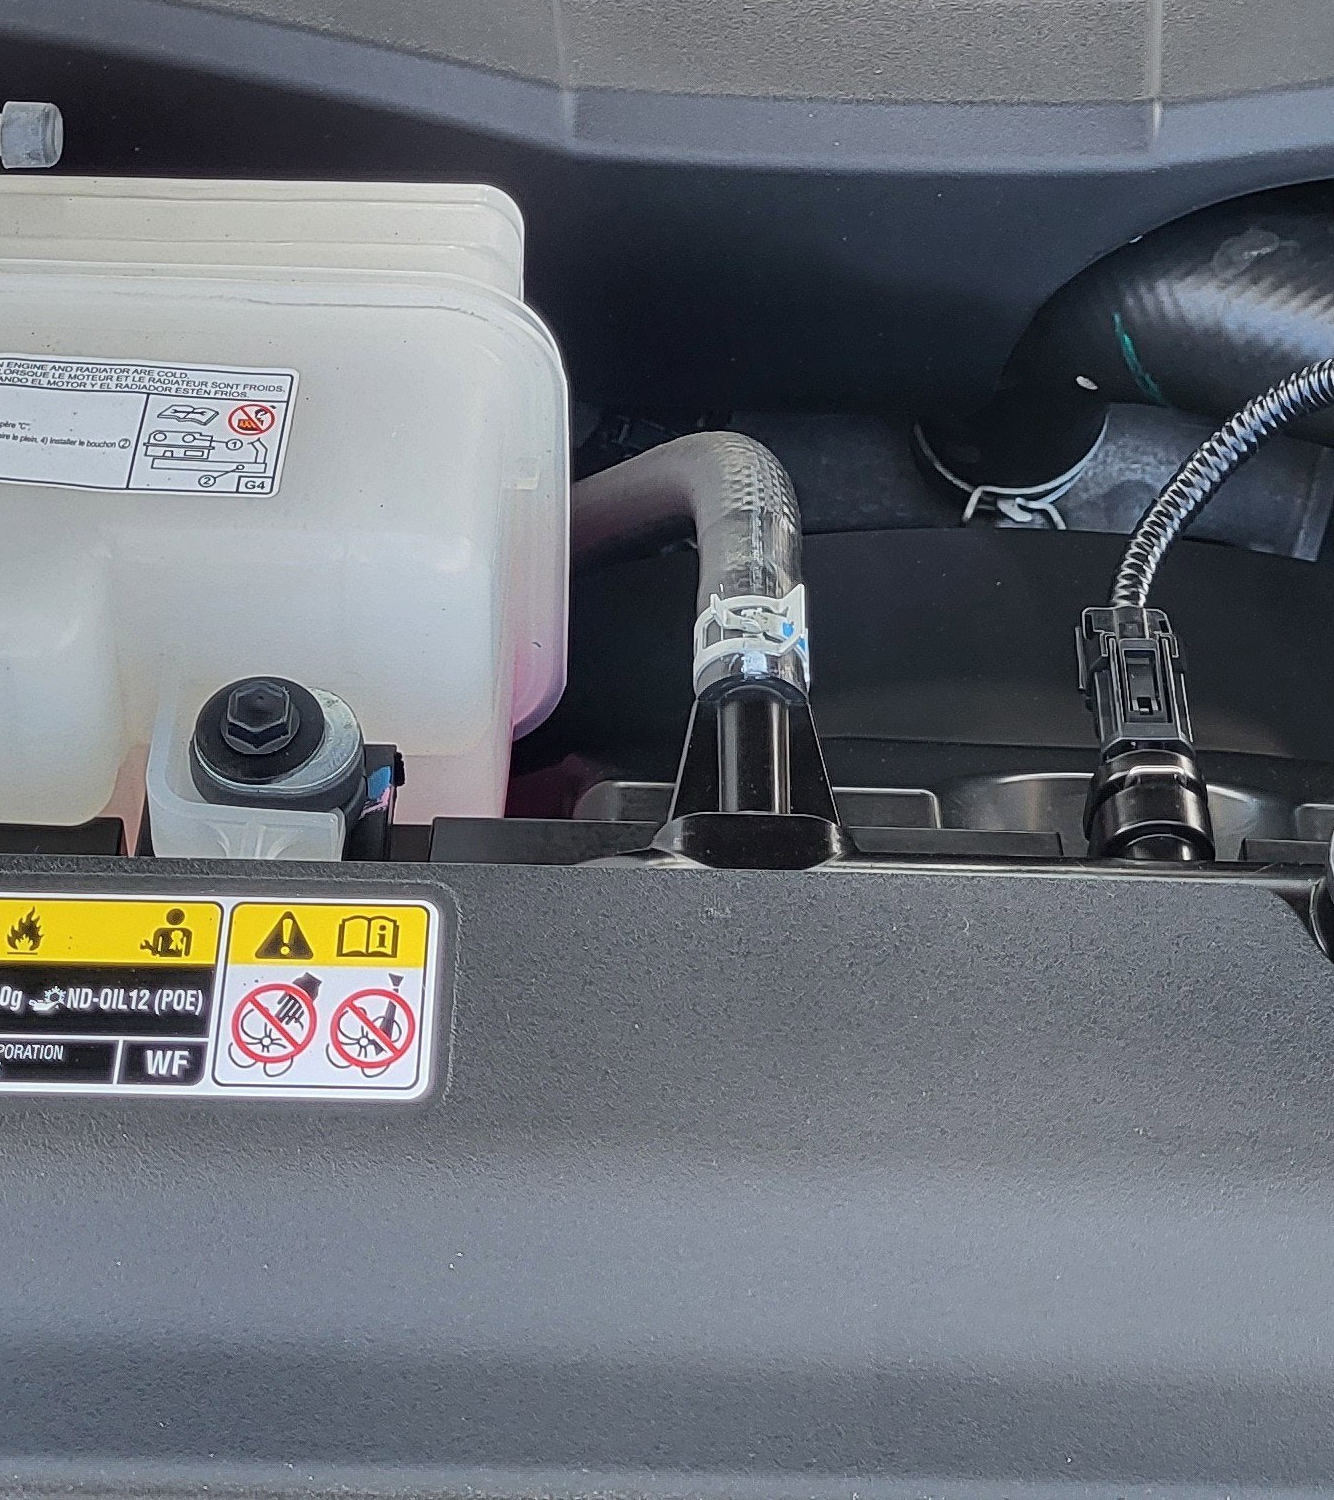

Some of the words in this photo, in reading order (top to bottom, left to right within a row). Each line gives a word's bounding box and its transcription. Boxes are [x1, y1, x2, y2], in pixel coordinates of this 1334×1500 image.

[6, 362, 47, 370] ENGINE
[76, 366, 129, 375] RADIATOR
[131, 368, 154, 376] ARE
[157, 371, 189, 379] COLD.
[47, 380, 87, 388] MOTOR
[115, 383, 172, 393] RADIADOR
[175, 387, 211, 396] ESTÉN
[152, 377, 208, 388] RADIATEUR
[211, 382, 240, 390] SONT
[243, 384, 285, 392] FROIDS.
[245, 480, 265, 490] G4
[154, 989, 203, 1015] (POE)
[146, 1050, 190, 1076] WF
